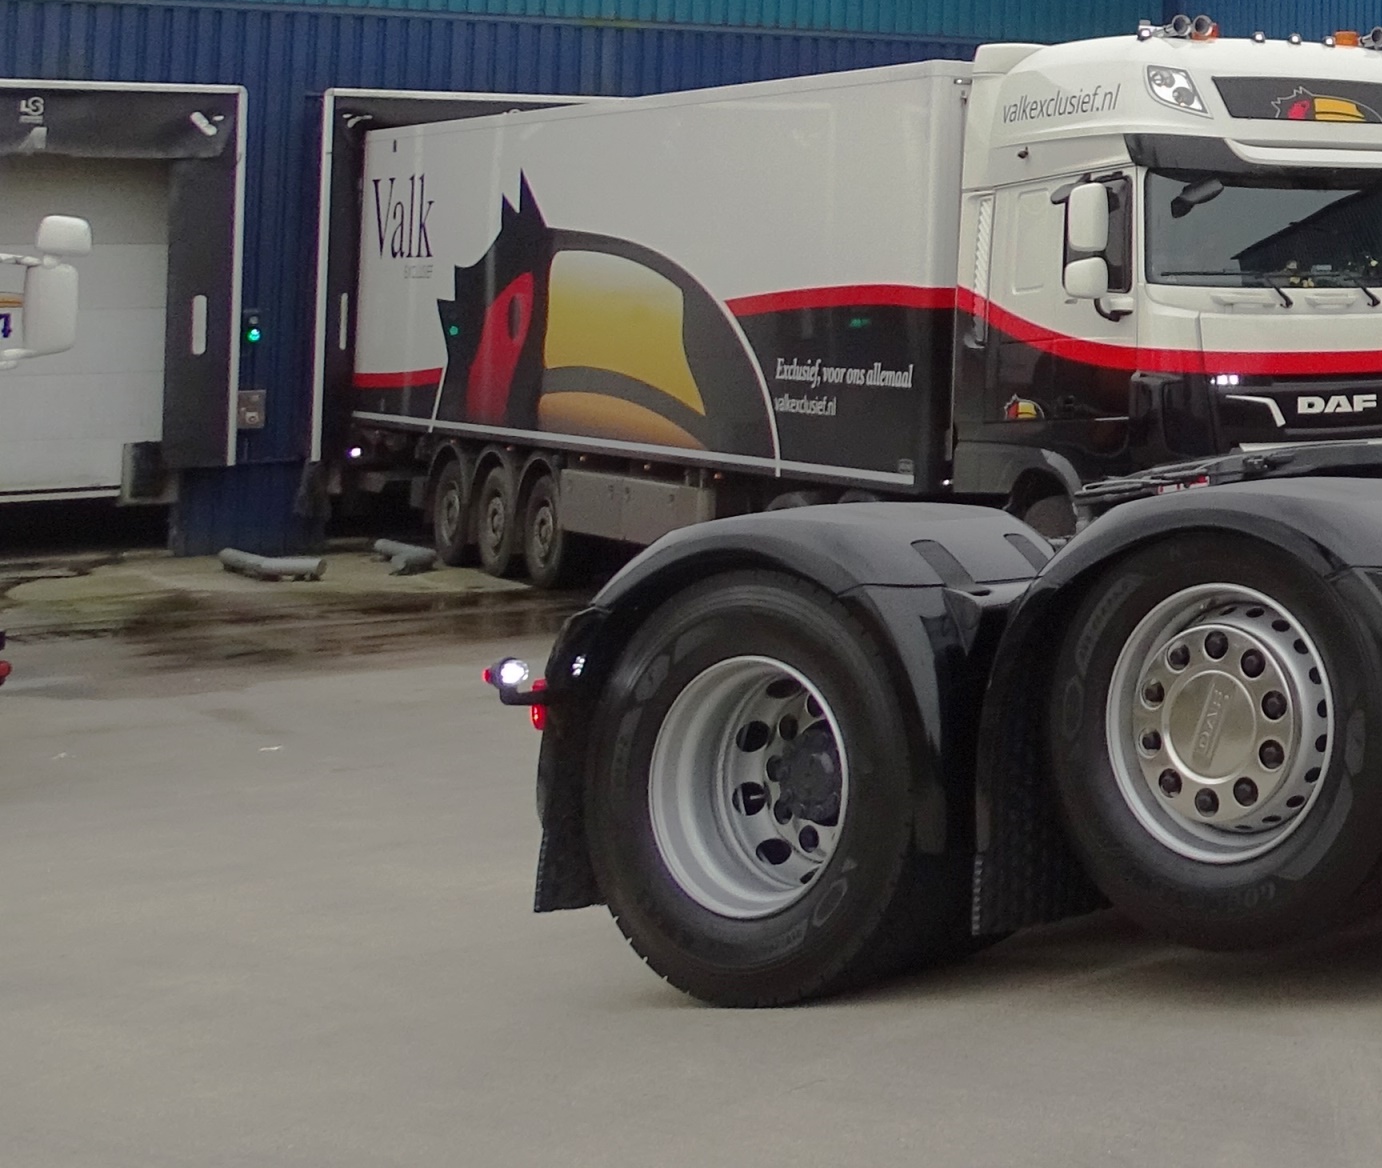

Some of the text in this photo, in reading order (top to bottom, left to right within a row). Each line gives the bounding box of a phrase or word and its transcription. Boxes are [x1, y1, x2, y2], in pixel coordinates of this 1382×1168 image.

[1003, 83, 1121, 124] valkexclusief.nl
[372, 173, 435, 259] Valk
[822, 366, 846, 383] voor
[847, 367, 865, 386] ons
[866, 362, 914, 389] allemaal
[774, 393, 837, 416] valkexclusief.nl
[1297, 394, 1377, 414] DAF
